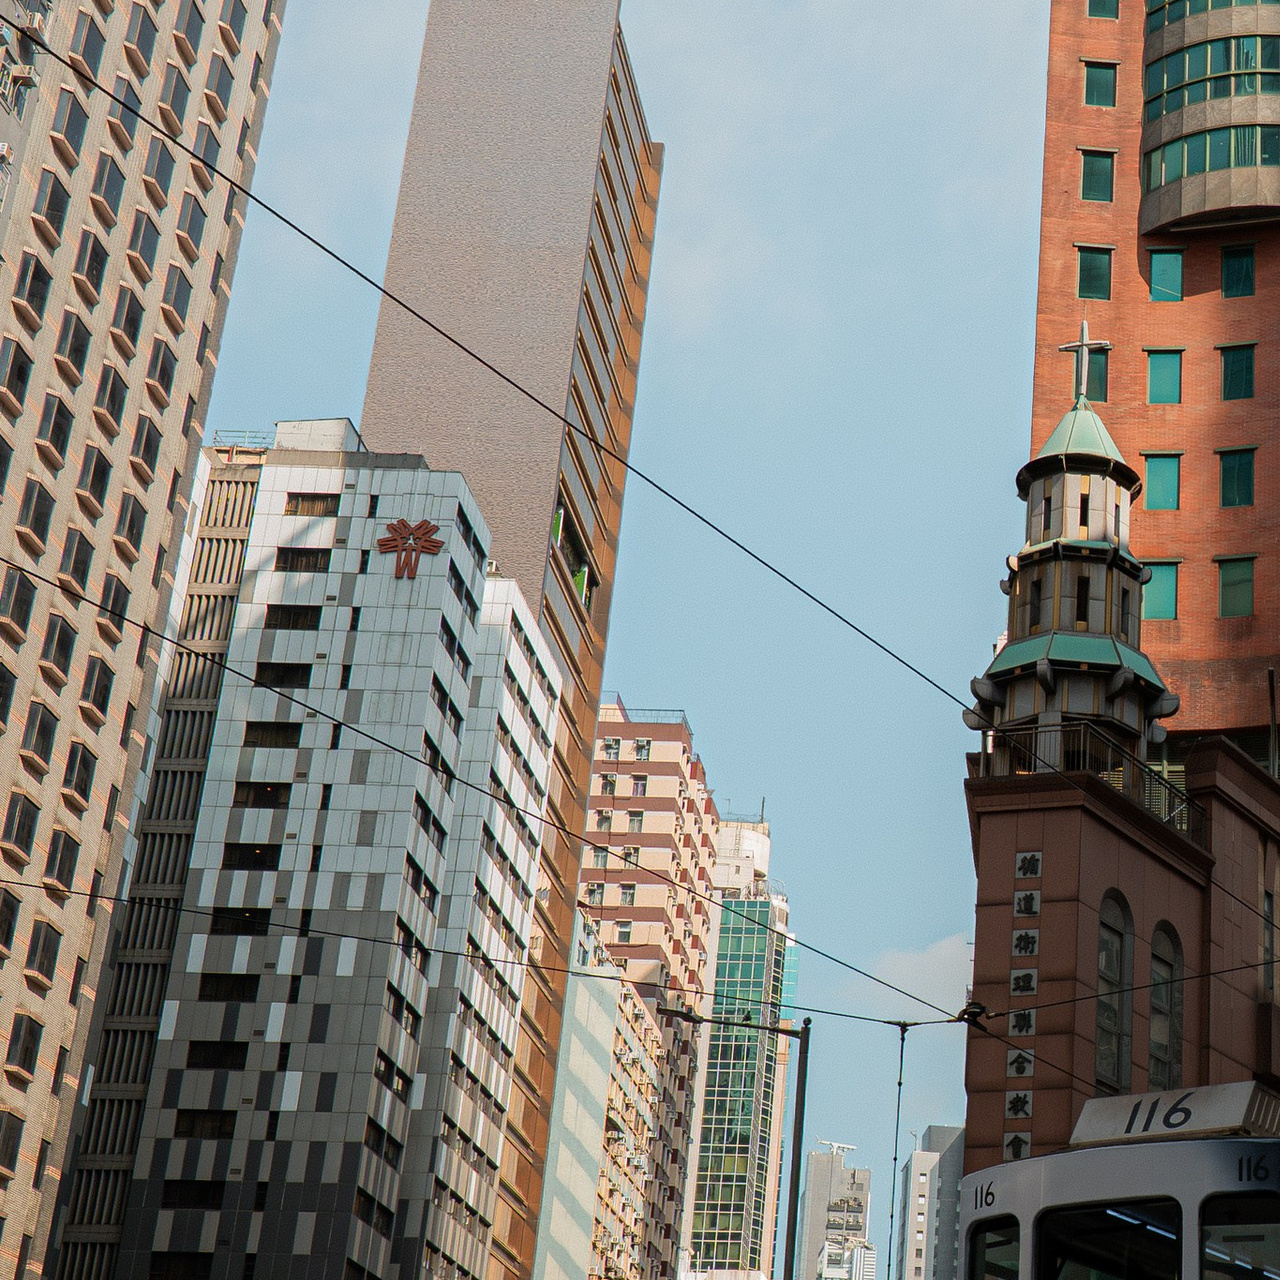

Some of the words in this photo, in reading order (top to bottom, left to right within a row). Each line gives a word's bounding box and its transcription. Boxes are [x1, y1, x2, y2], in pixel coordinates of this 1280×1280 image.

[1124, 1091, 1196, 1134] 116
[1238, 1154, 1270, 1182] 116
[974, 1181, 996, 1210] 116
